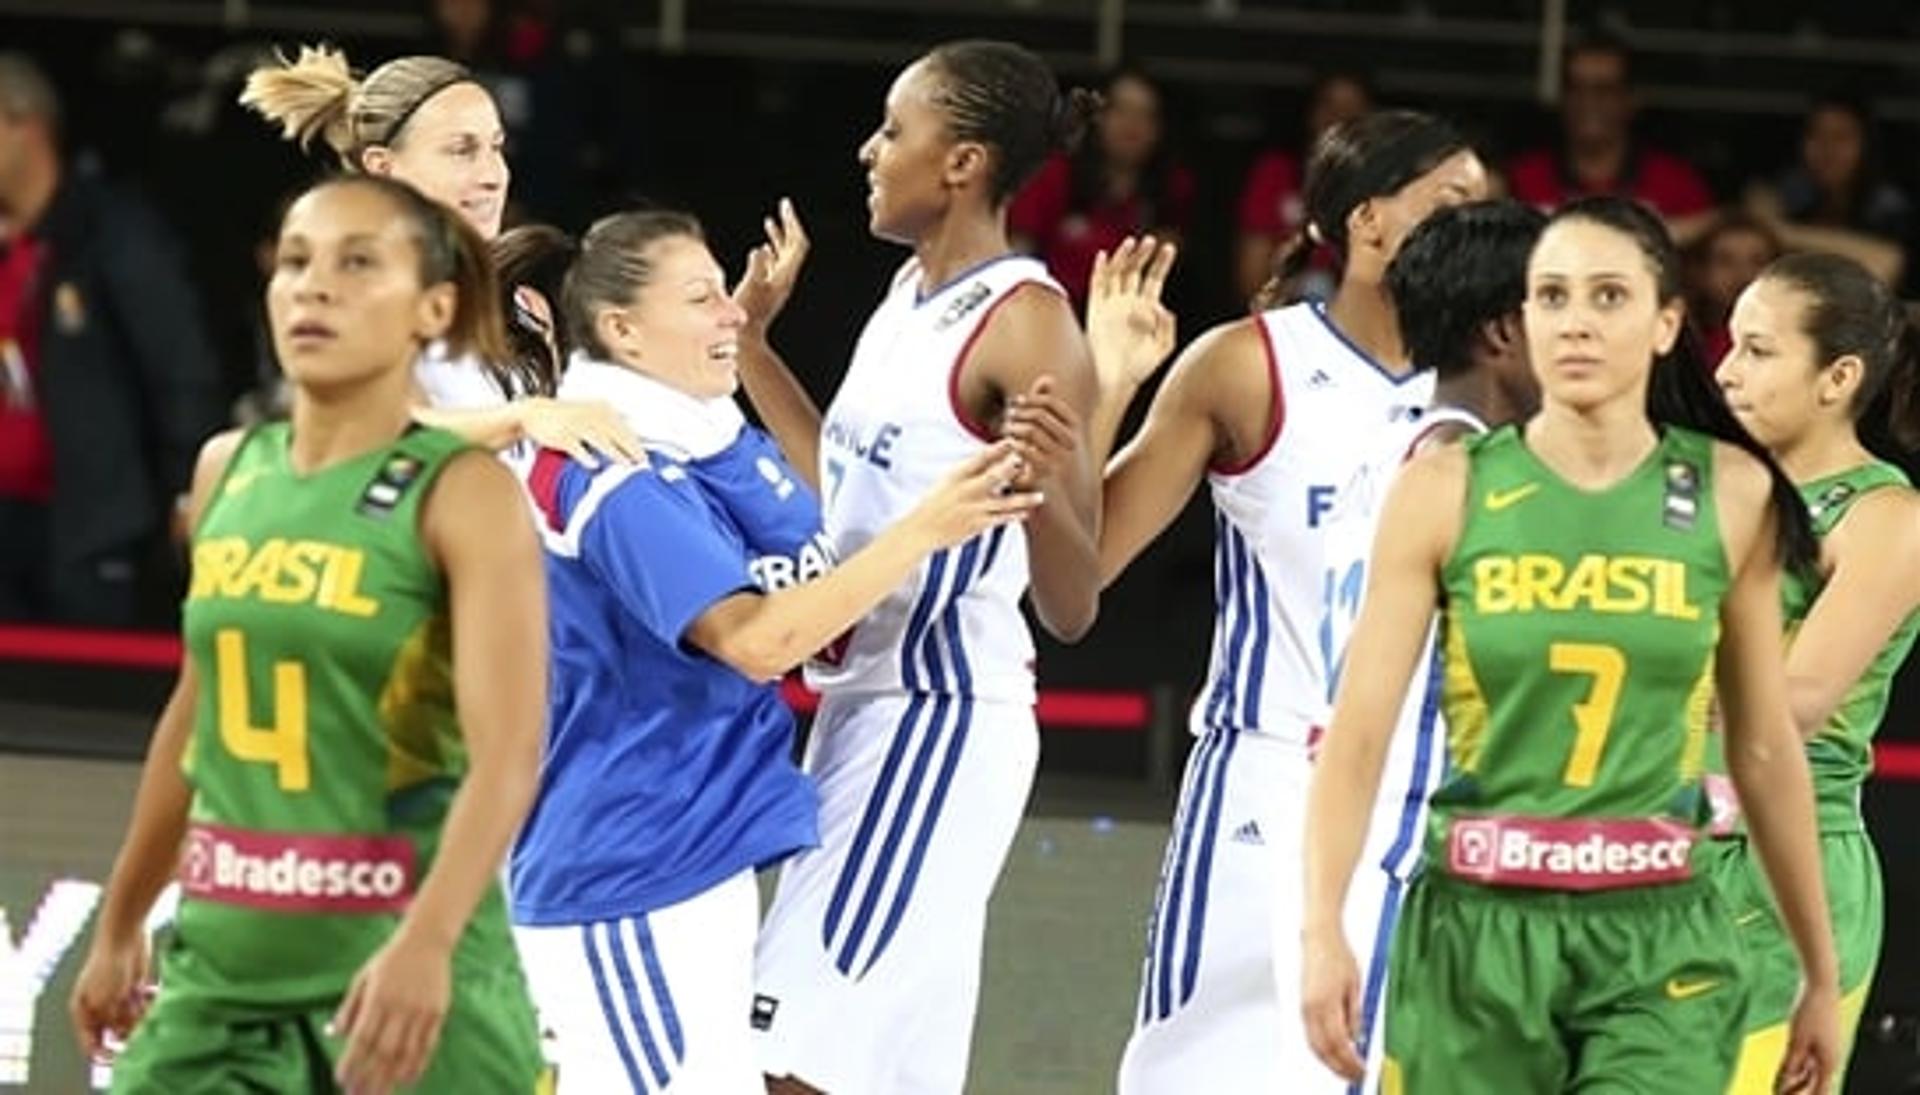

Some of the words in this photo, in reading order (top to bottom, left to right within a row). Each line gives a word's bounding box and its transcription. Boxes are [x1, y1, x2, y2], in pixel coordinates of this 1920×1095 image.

[1474, 554, 1701, 620] BRASIL
[216, 629, 309, 790] 4
[1550, 642, 1627, 787] 7
[214, 841, 405, 897] Bradesco
